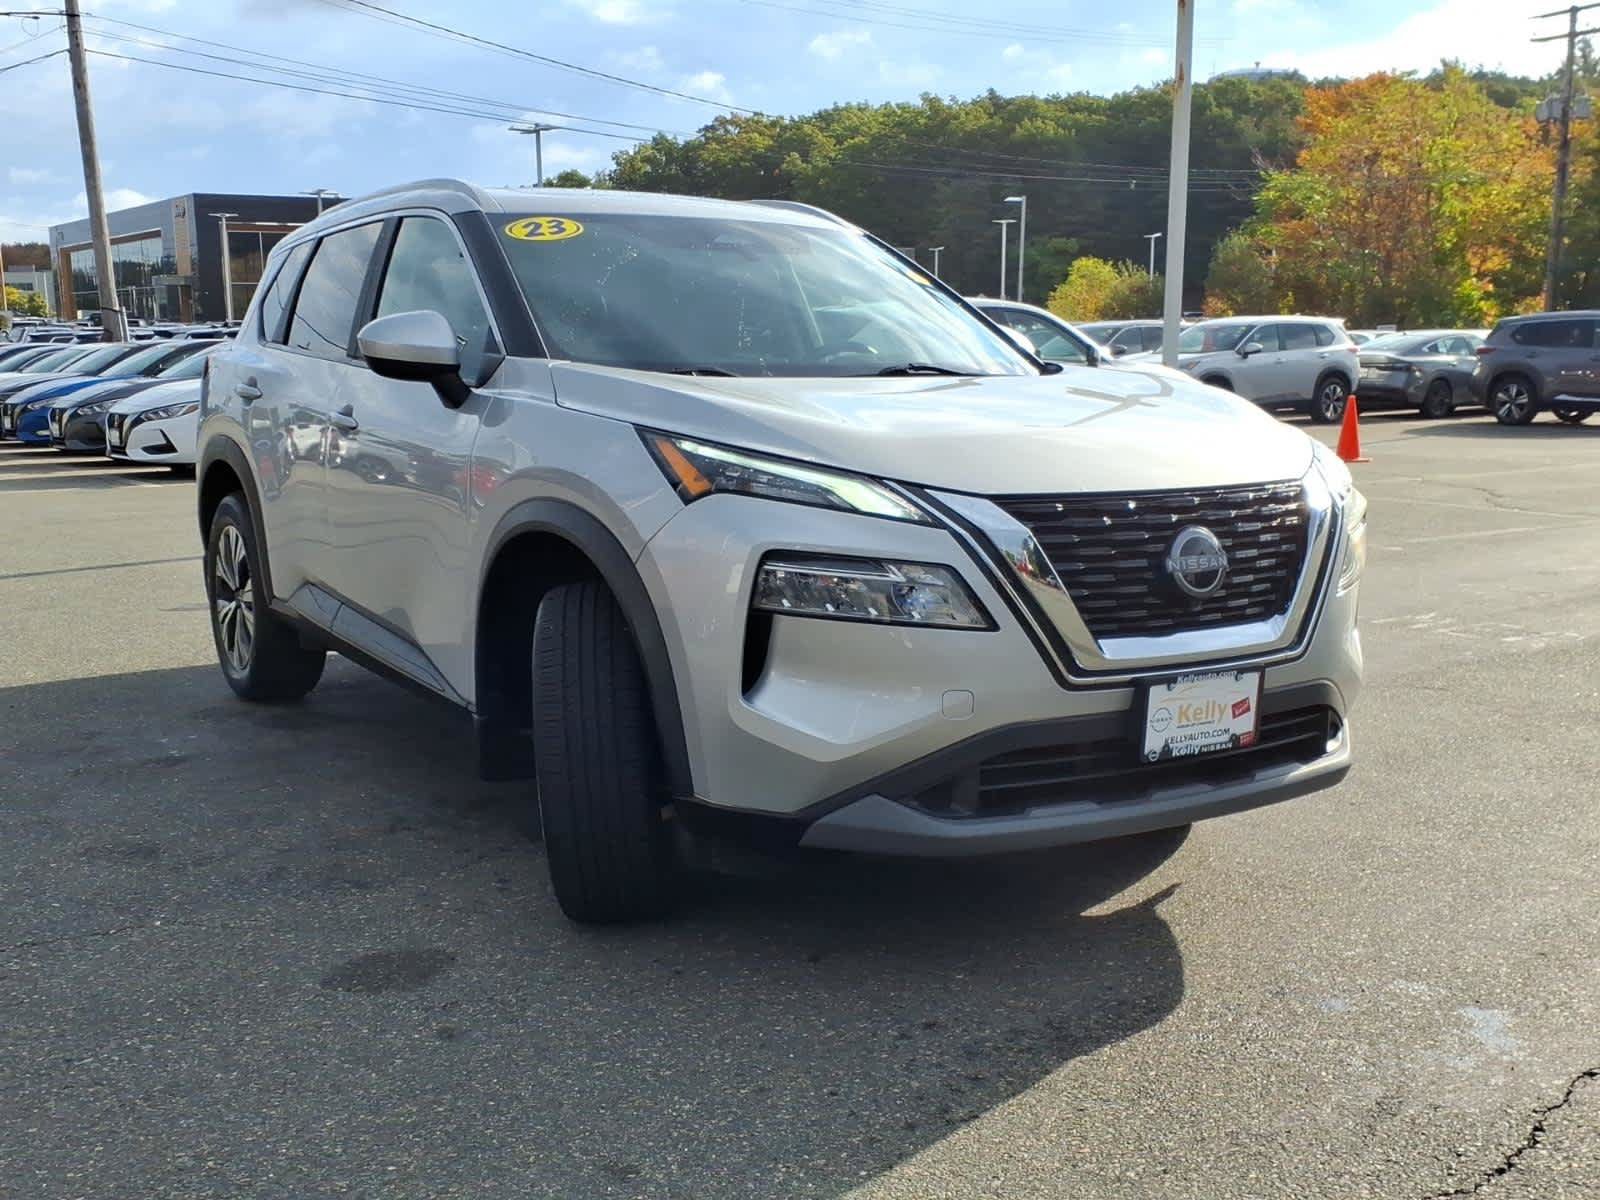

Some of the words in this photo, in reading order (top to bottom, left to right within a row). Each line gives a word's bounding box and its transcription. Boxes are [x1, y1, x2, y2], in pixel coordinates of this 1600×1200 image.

[522, 219, 567, 237] 23
[1167, 556, 1229, 573] NISSAN
[1177, 700, 1228, 724] Kelly
[1165, 728, 1230, 745] KELLYAUTO.COM
[1171, 743, 1200, 757] Kelly
[1201, 743, 1232, 753] NISSAN
